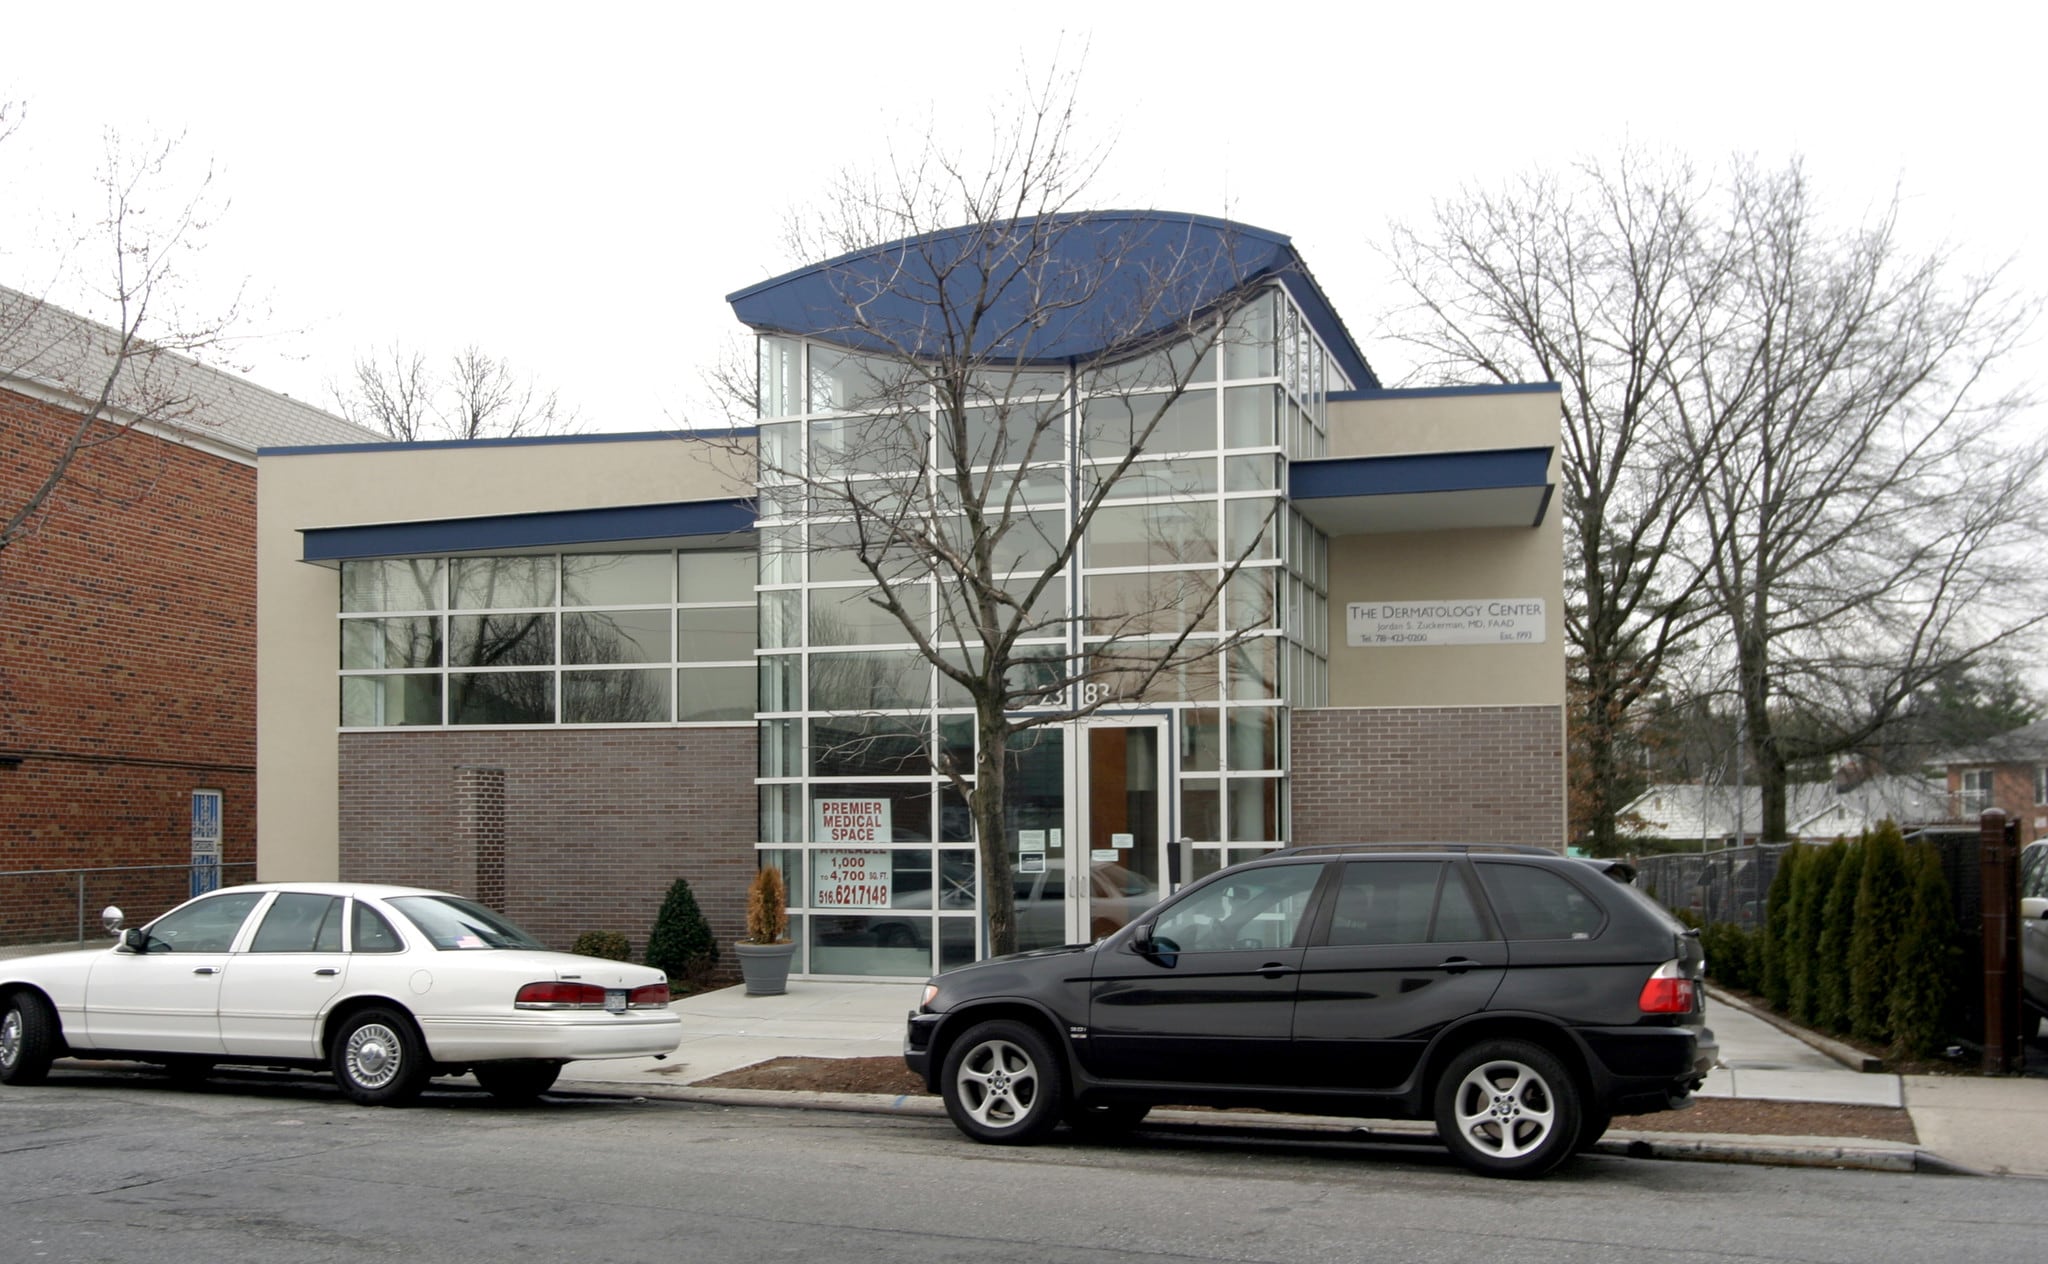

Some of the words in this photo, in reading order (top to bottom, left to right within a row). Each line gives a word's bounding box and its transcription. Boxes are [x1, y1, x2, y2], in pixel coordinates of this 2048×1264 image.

[1349, 606, 1377, 619] THE
[1382, 605, 1482, 619] DERMATOLOGY
[1488, 602, 1542, 617] CENTER
[1488, 619, 1515, 628] FAAD
[822, 802, 882, 814] PREMIER
[823, 815, 882, 828] MEDICAL
[831, 828, 875, 840] SPACE
[831, 857, 865, 869] 1,000
[830, 871, 865, 883] 4,700
[818, 885, 888, 905] 516.621.7148
